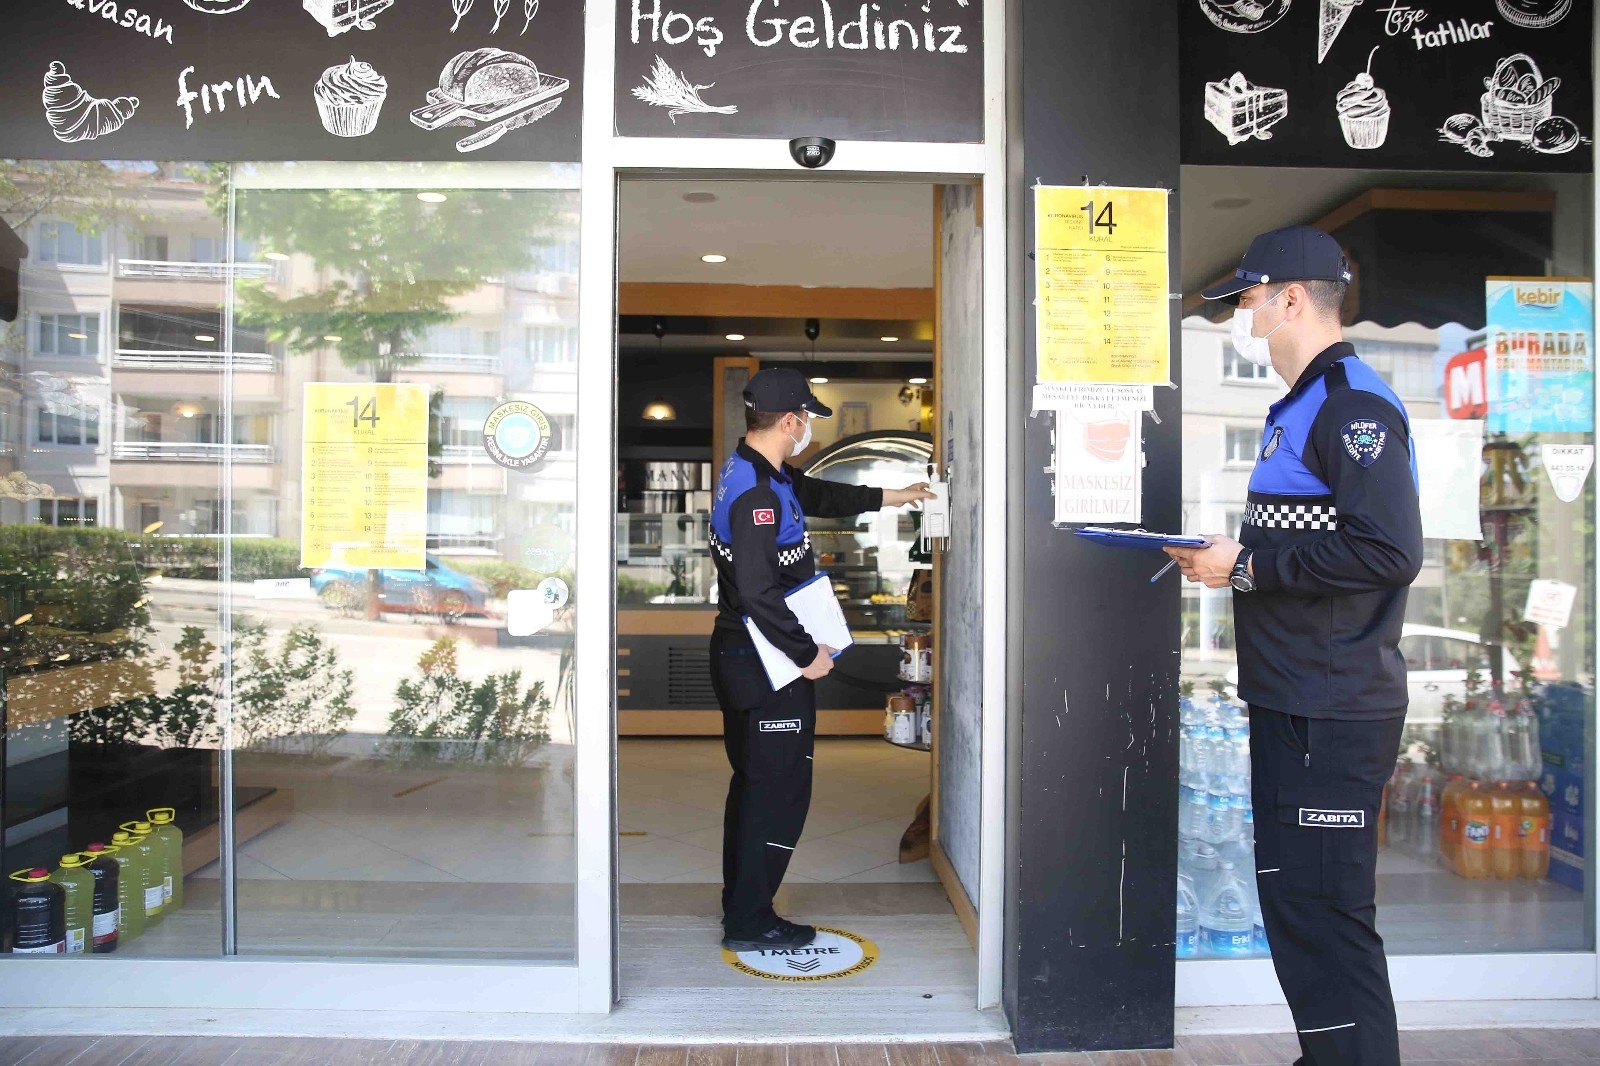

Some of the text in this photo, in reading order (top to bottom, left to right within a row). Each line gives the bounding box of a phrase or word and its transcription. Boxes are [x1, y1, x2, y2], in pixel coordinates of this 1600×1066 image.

[630, 0, 969, 57] Hoş Geldiniz
[1376, 0, 1429, 36] taze
[1411, 18, 1494, 51] tatlılar
[176, 66, 281, 130] fırın
[1080, 200, 1117, 235] 14
[1516, 288, 1561, 304] kebir
[1495, 332, 1587, 356] BURADA
[345, 396, 381, 429] 14
[488, 404, 529, 430] MASKESİZ
[1064, 472, 1132, 491] MASKESİZ
[1064, 495, 1131, 515] GİRİLMEZ
[1306, 813, 1359, 823] ZABITA
[770, 947, 841, 957] METRE
